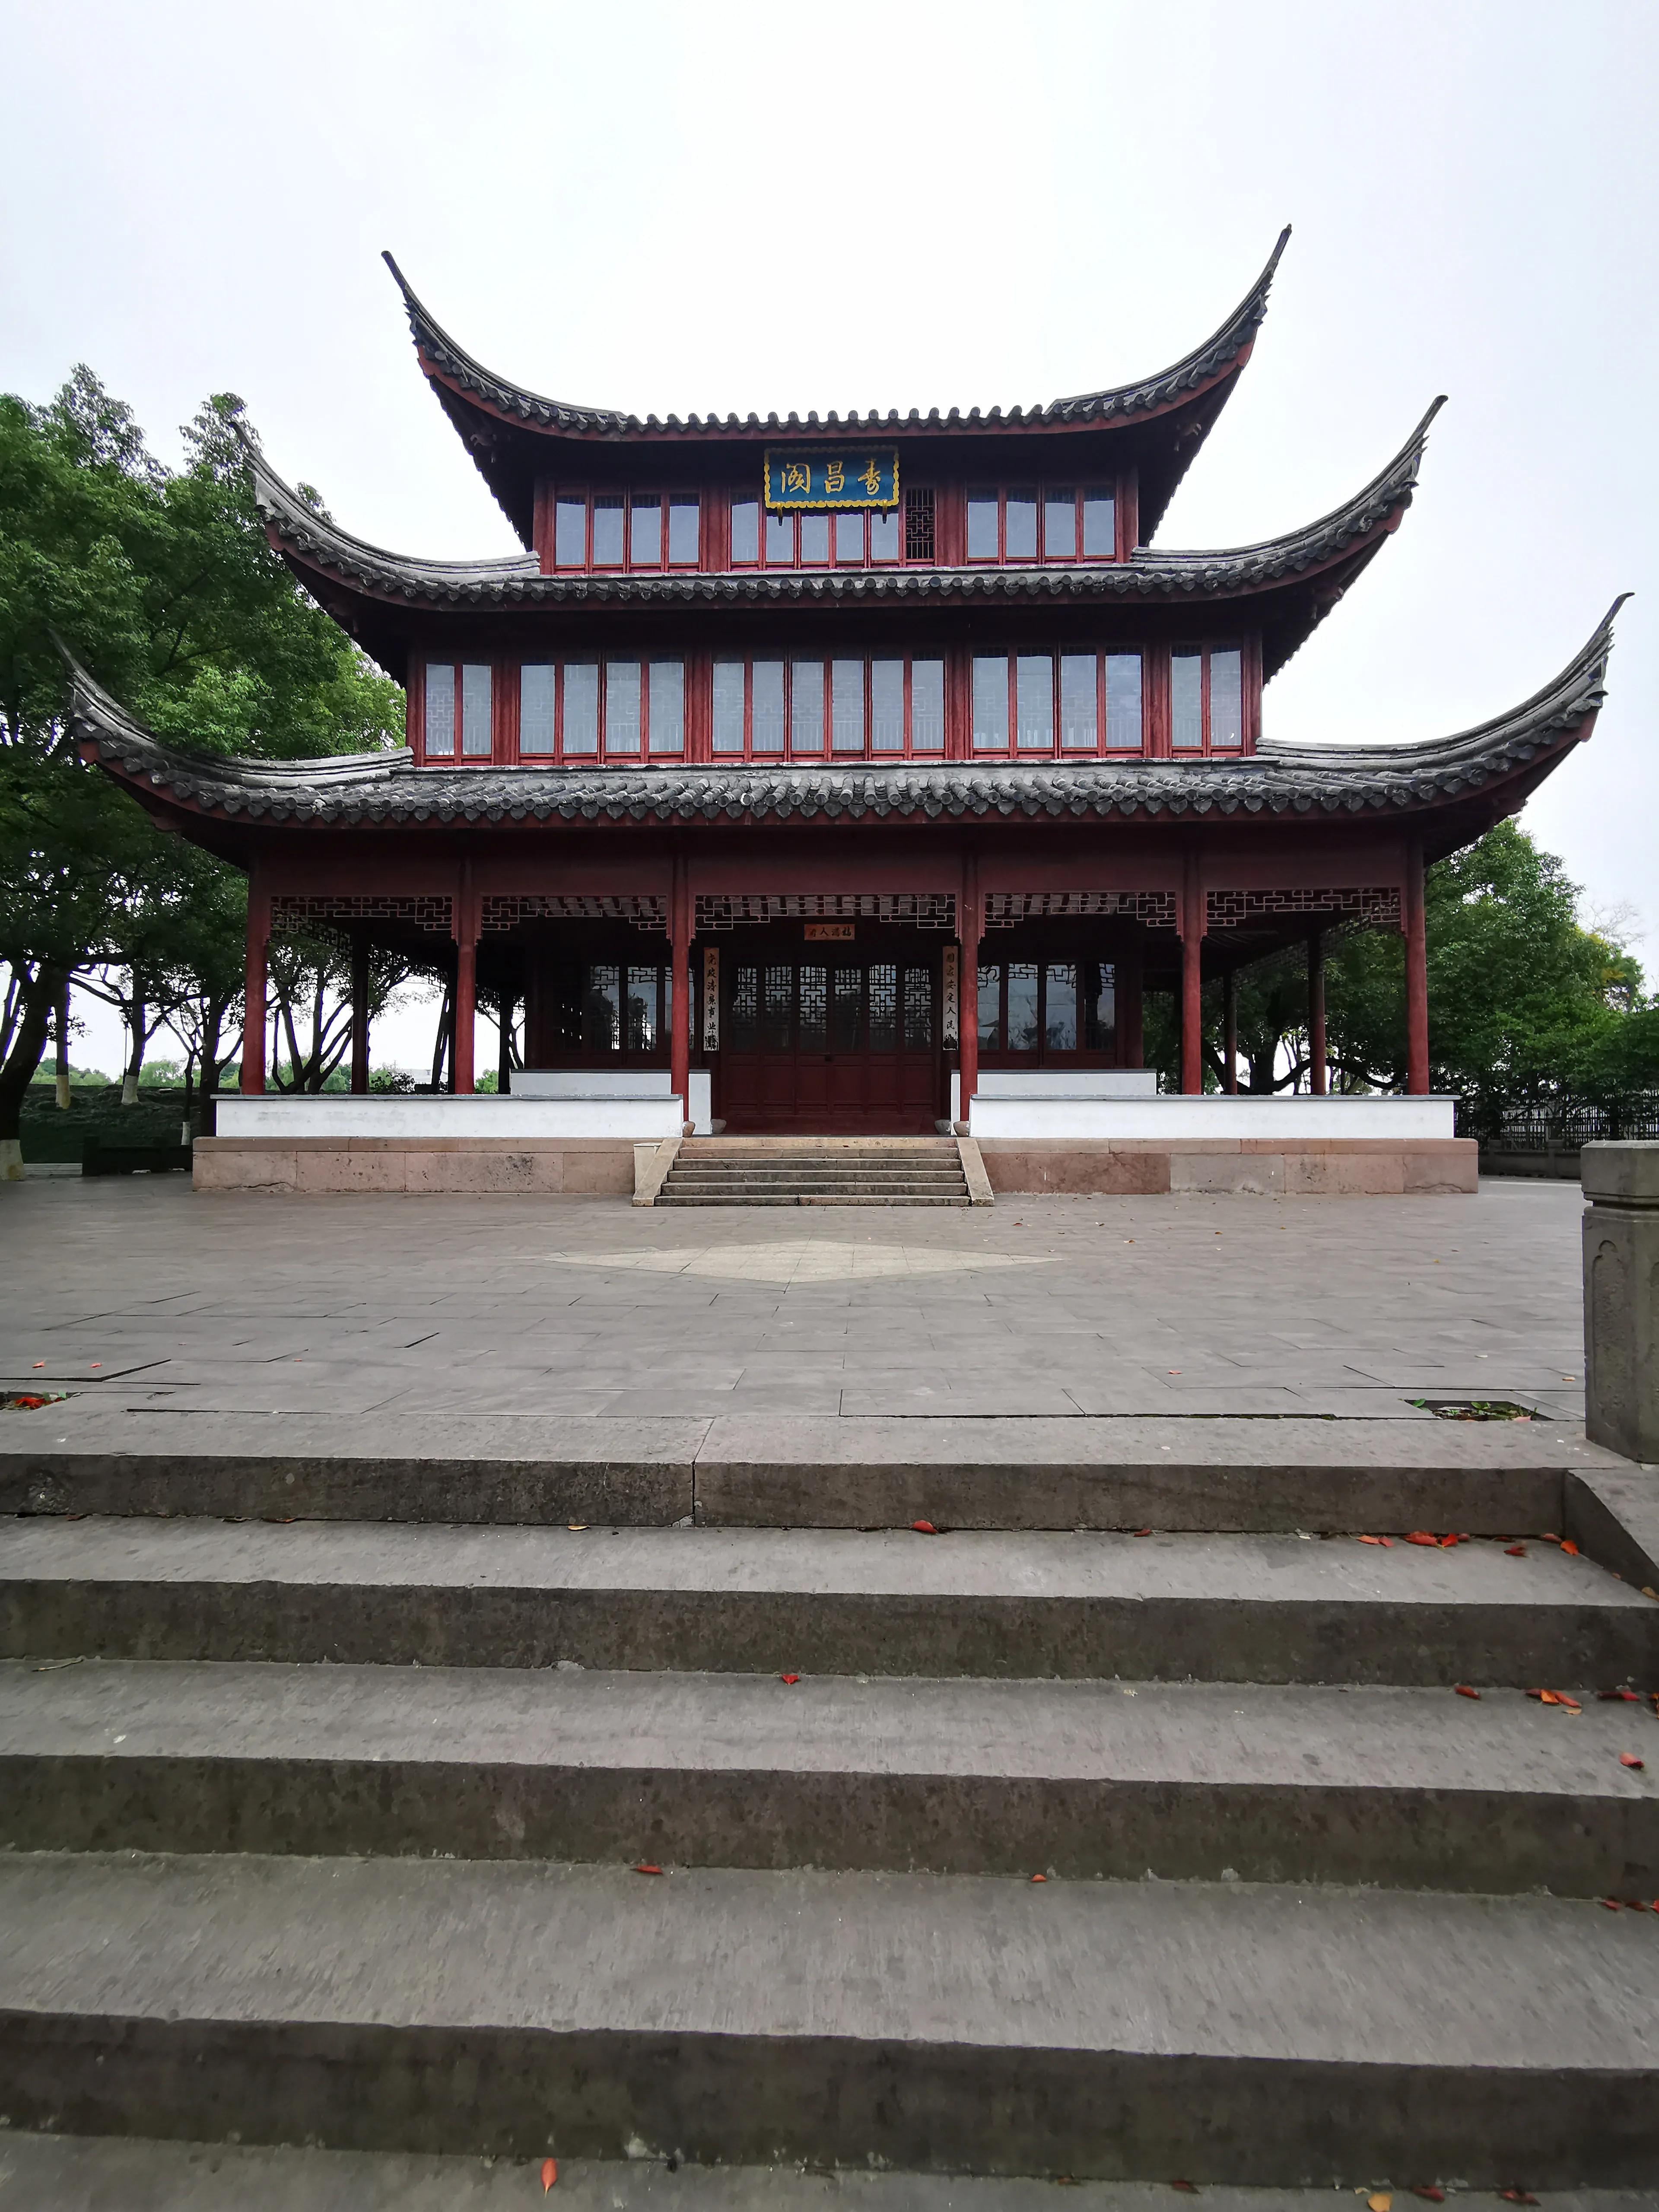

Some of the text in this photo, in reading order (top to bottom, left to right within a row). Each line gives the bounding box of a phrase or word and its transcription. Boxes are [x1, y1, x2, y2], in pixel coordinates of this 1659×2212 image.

[946, 952, 957, 1049] 国家安定人民
